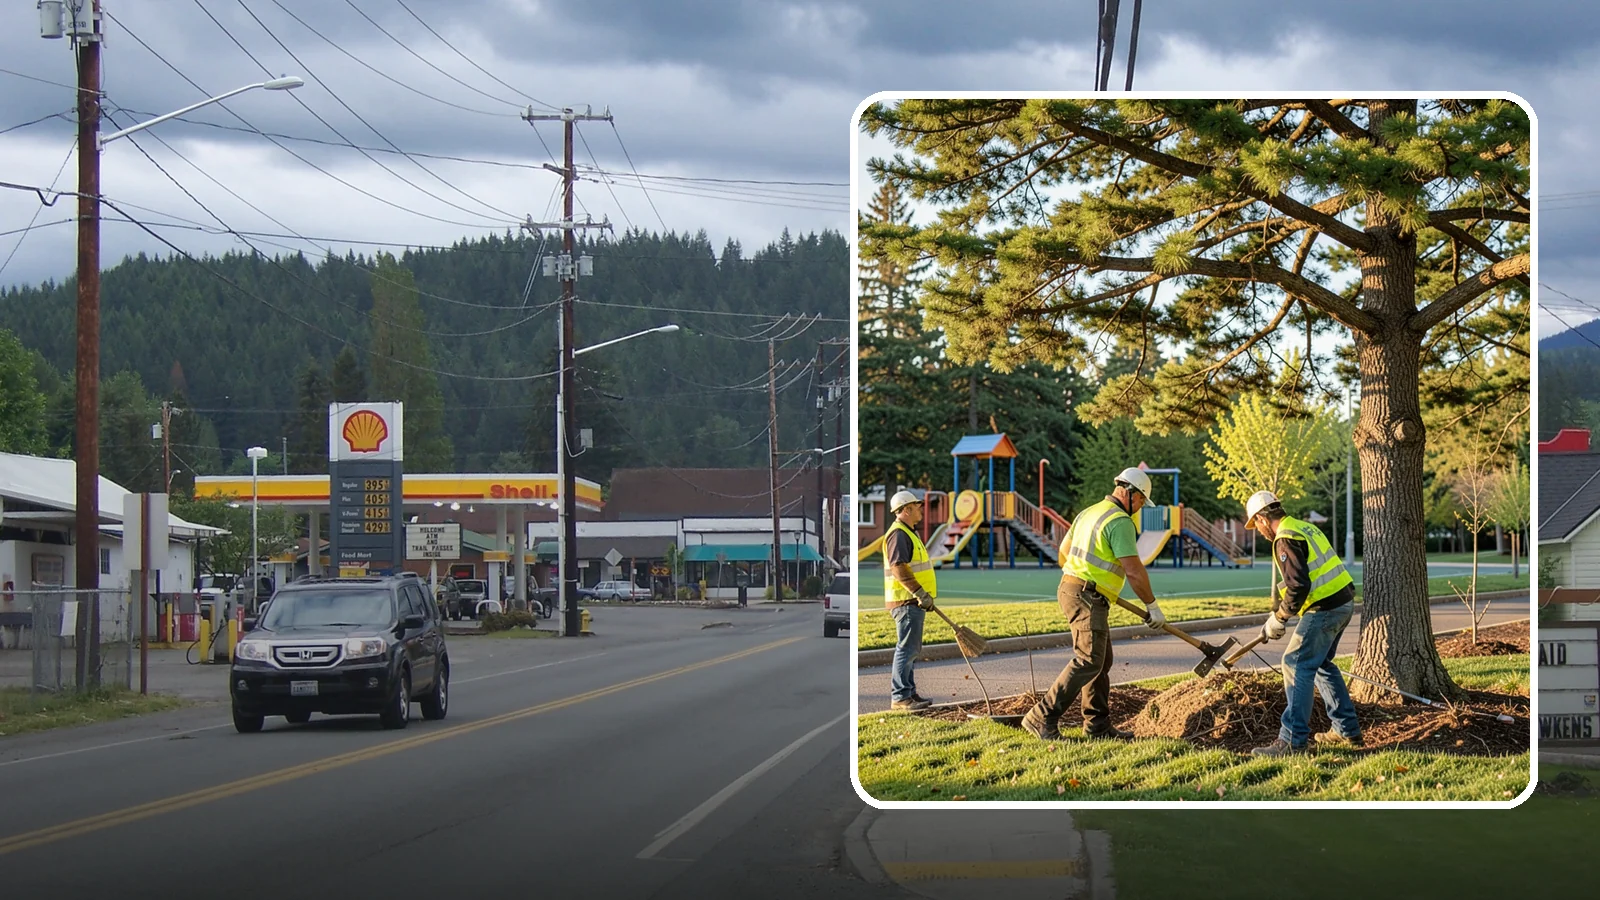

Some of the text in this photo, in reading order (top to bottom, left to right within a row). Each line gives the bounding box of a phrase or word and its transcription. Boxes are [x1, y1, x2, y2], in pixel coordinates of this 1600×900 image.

[366, 480, 383, 490] 395
[490, 484, 547, 499] Shell
[366, 494, 383, 504] 405
[366, 508, 383, 518] 415
[366, 522, 383, 532] 429
[1539, 643, 1567, 666] AID
